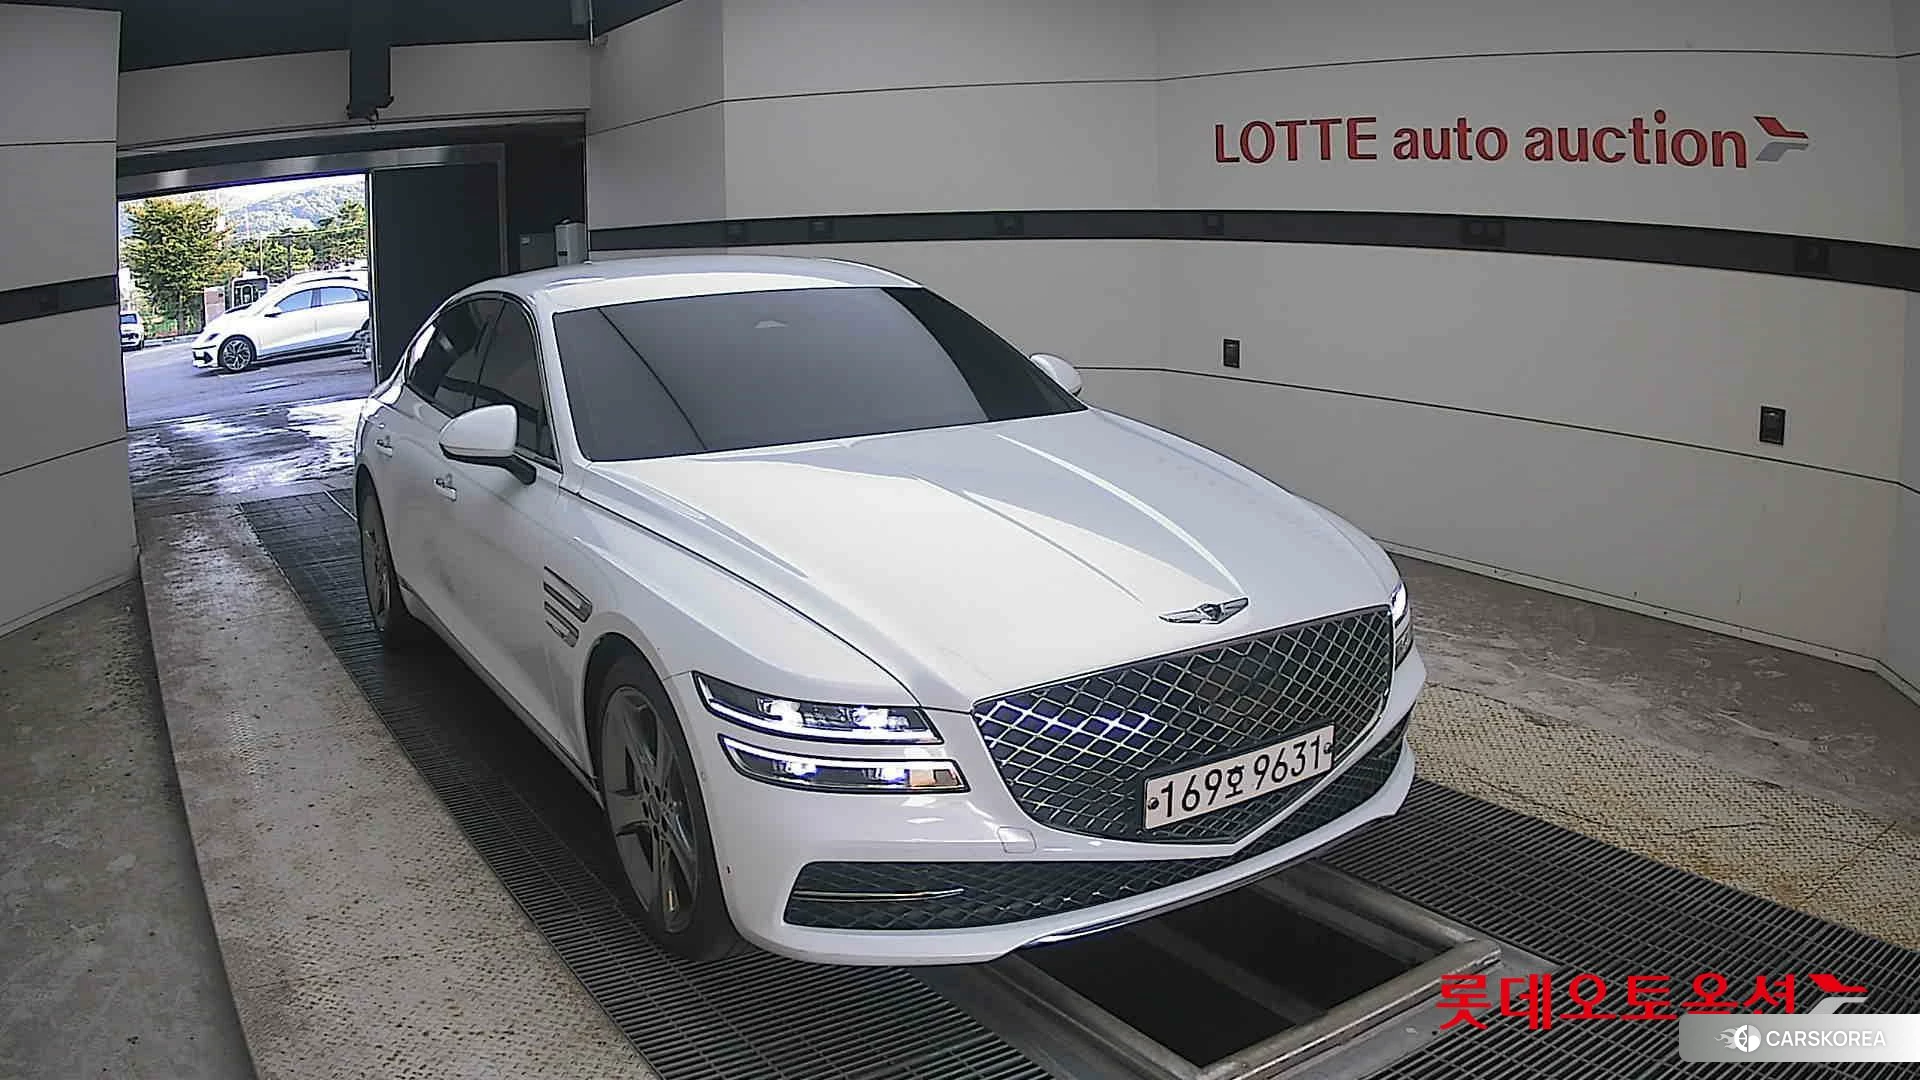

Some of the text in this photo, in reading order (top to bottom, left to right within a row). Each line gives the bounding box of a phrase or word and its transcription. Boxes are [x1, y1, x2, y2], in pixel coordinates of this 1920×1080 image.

[1215, 109, 1747, 169] LOTTE auto auction
[1160, 735, 1321, 818] 169호 9631
